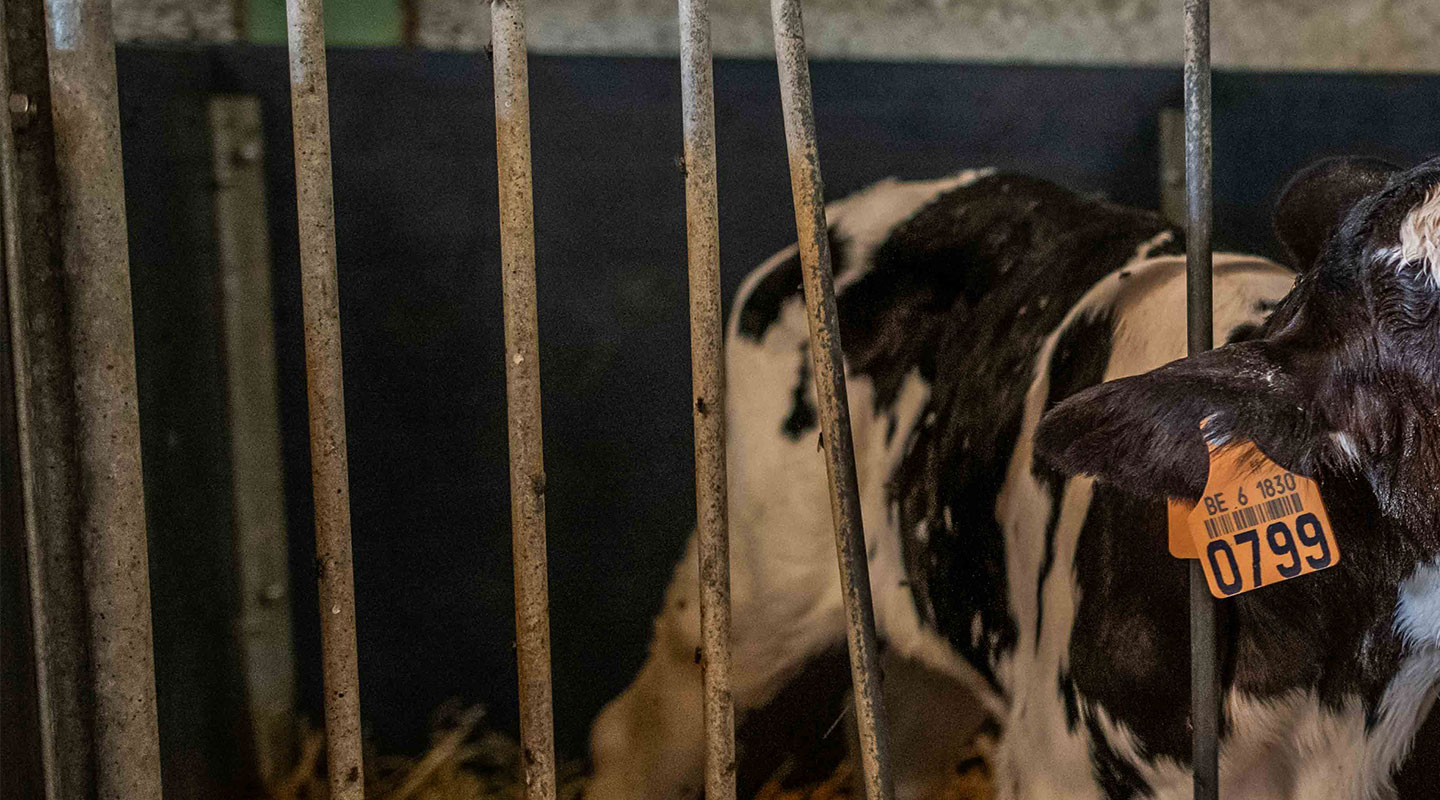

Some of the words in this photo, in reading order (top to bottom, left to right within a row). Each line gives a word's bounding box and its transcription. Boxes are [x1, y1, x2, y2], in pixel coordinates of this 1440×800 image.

[1204, 492, 1228, 515] BE
[1237, 486, 1249, 506] 6
[1256, 472, 1296, 498] 1830
[1206, 512, 1332, 595] 0799
